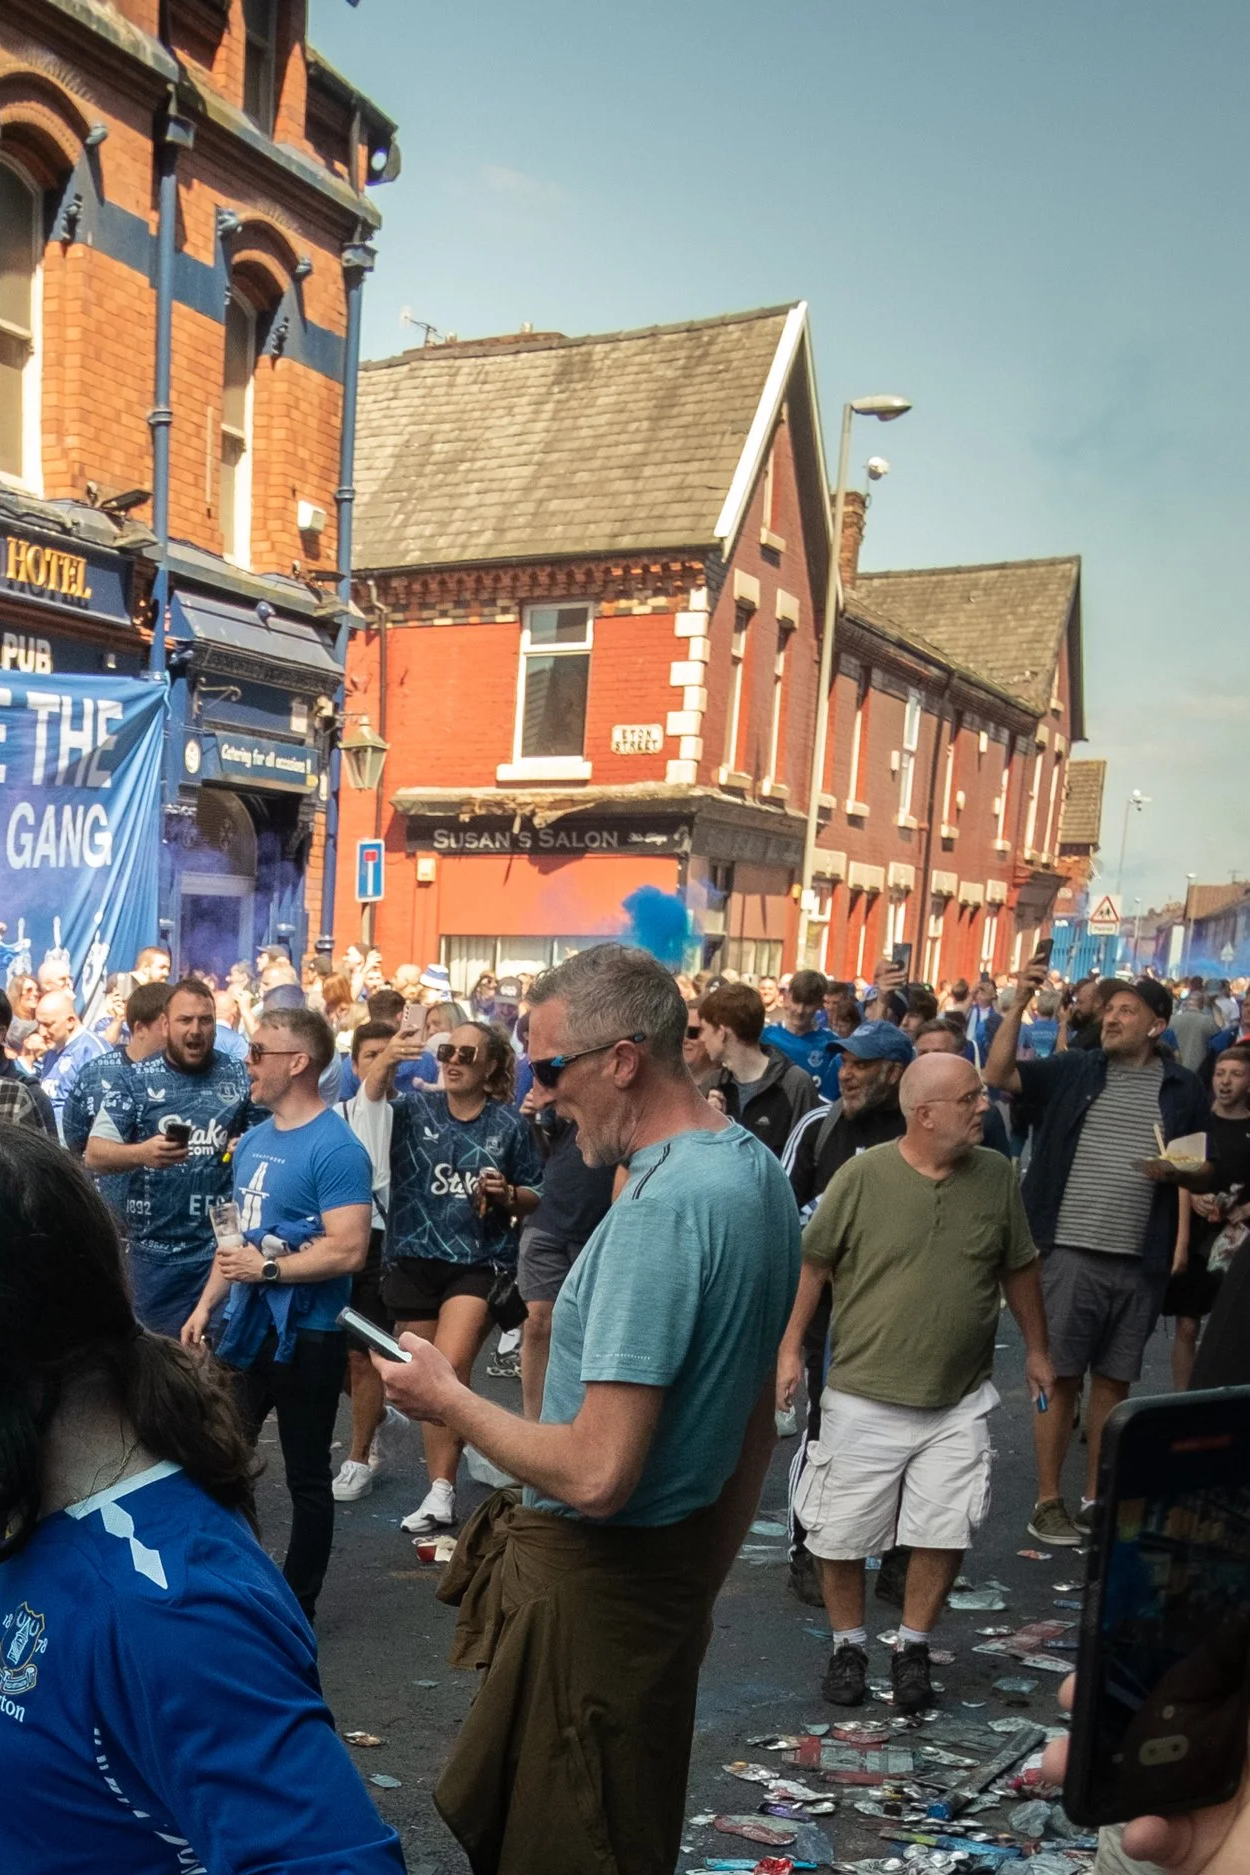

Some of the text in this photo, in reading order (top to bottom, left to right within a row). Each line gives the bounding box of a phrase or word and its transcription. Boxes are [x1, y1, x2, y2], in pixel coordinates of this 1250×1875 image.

[6, 535, 92, 599] HOTEL
[1, 623, 52, 675] PUB
[27, 690, 124, 789] THE
[615, 740, 658, 752] STREET
[221, 743, 252, 768] Catering
[252, 749, 266, 766] for
[6, 802, 113, 870] GANG
[433, 828, 533, 849] SUSANS
[538, 829, 619, 849] SALON
[188, 1144, 214, 1156] com
[2, 1613, 14, 1629] 18
[35, 1637, 49, 1654] 78
